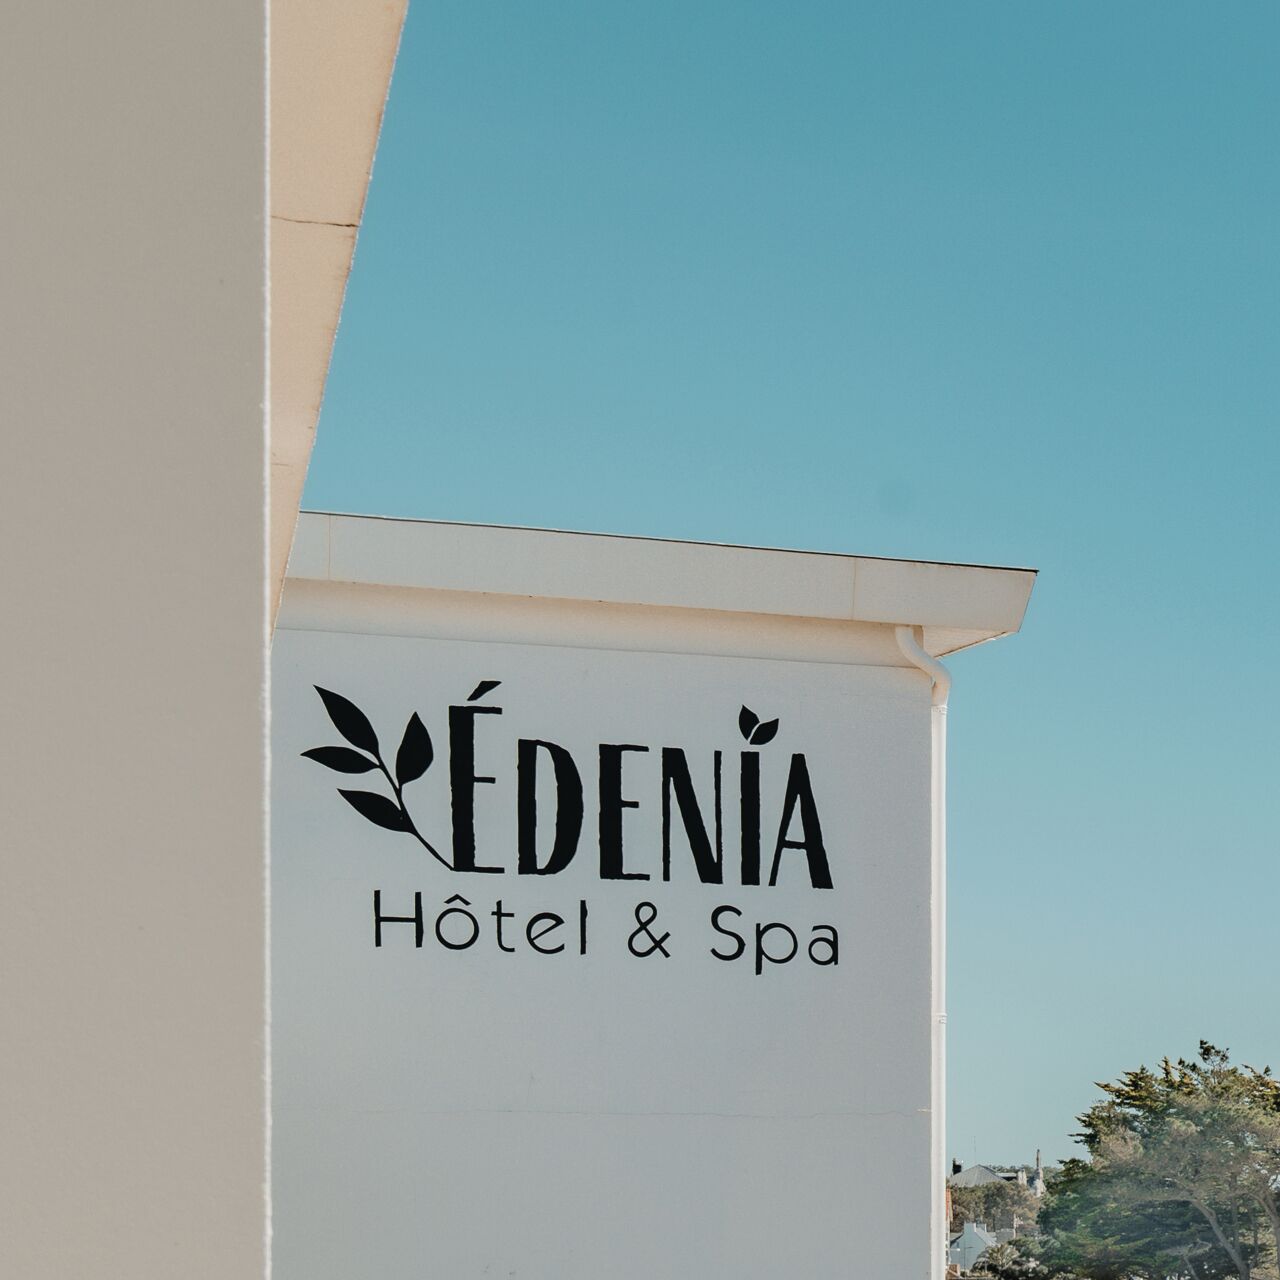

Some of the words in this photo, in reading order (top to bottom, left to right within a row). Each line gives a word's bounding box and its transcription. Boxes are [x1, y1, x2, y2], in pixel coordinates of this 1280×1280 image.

[448, 680, 834, 890] ÉDENIA
[373, 889, 588, 955] Hôtel
[627, 901, 671, 958] &
[710, 904, 839, 976] Spa
